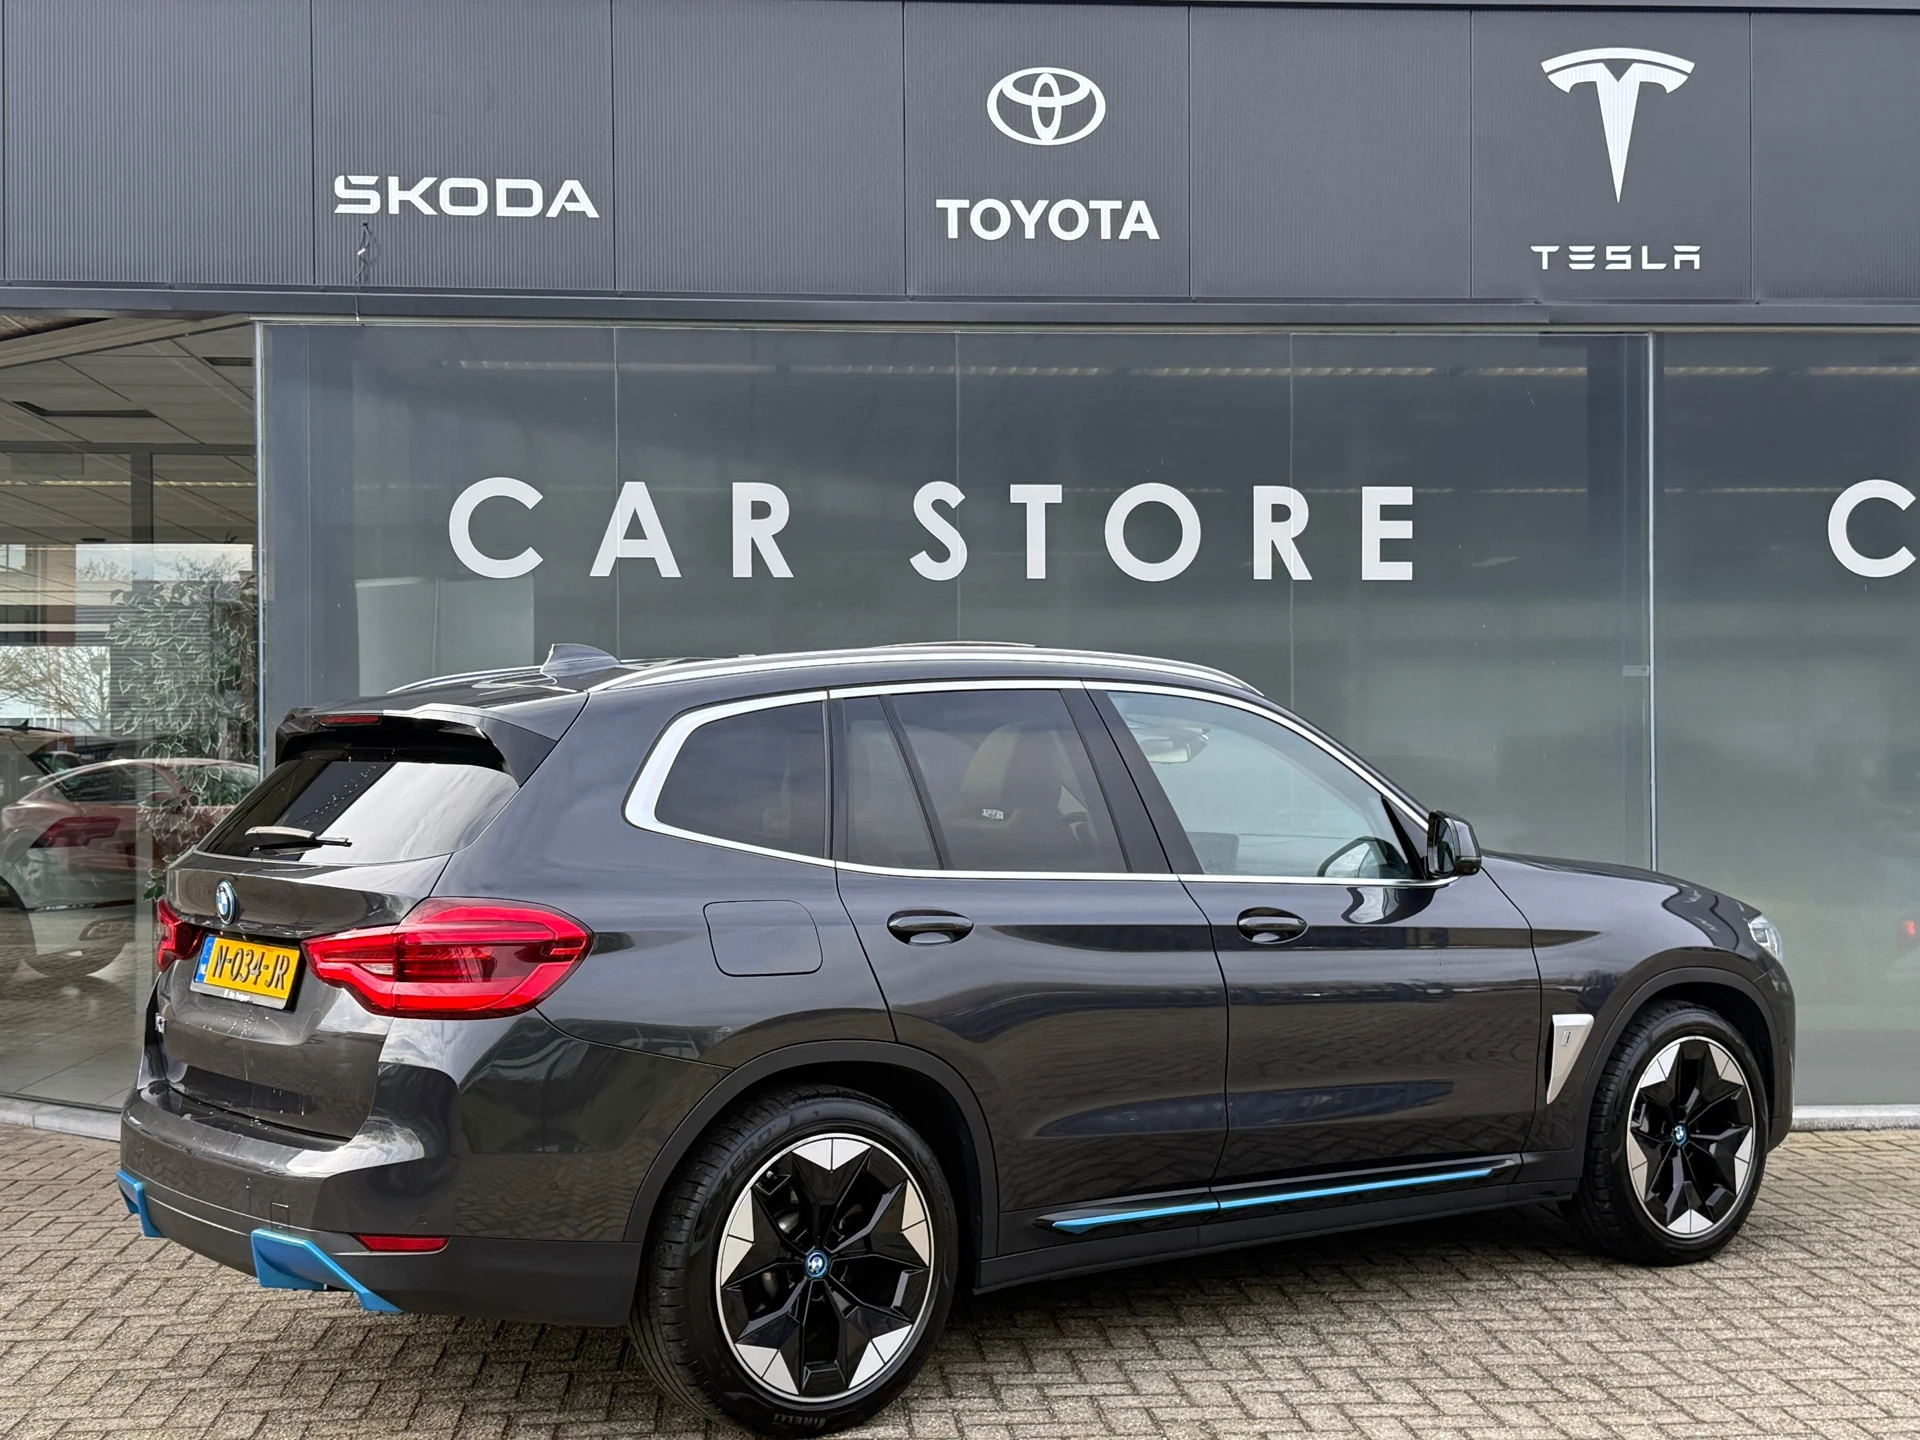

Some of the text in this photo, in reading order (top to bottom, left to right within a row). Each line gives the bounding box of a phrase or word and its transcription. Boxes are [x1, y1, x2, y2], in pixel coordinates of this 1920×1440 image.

[935, 198, 1160, 241] TOYOTA
[1530, 245, 1701, 270] TESLA
[448, 477, 1413, 582] CAR STORE
[211, 944, 291, 991] N-034-JR
